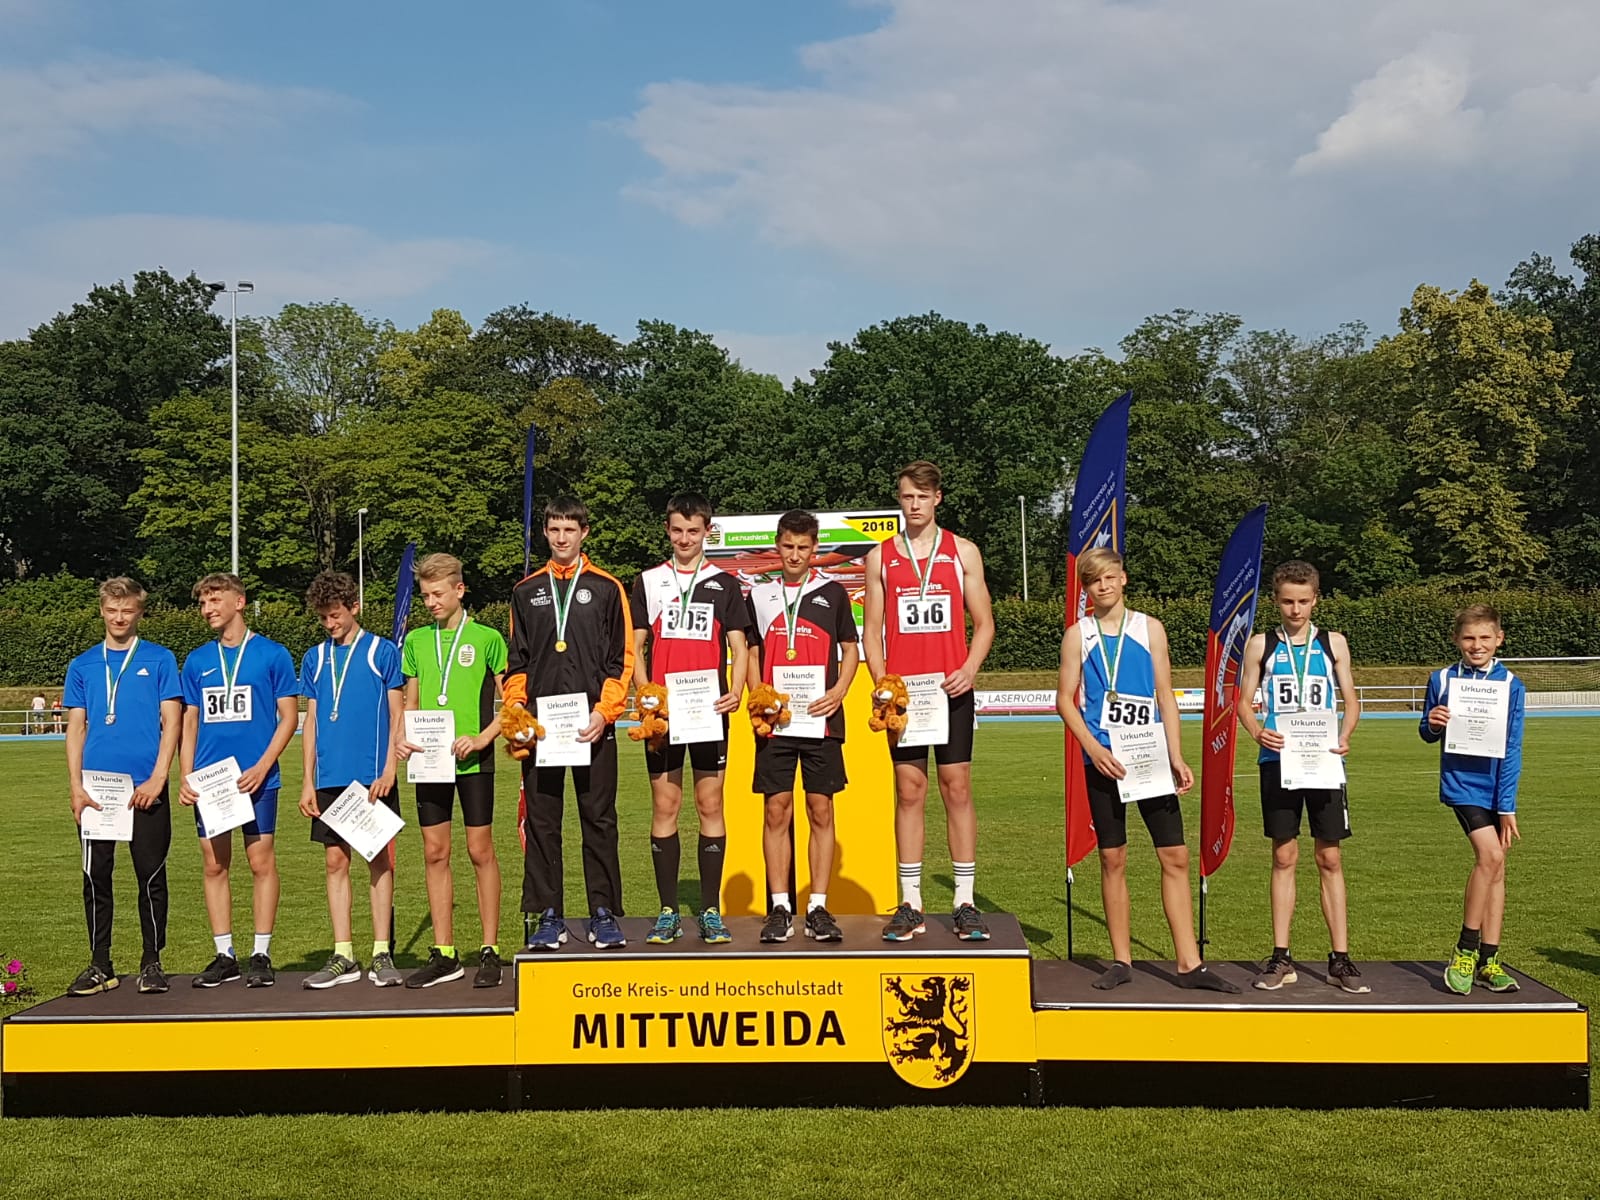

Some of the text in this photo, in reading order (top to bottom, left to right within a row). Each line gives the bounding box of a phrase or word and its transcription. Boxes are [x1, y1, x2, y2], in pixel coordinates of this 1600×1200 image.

[862, 521, 894, 532] 2018
[906, 603, 944, 625] 316
[676, 676, 708, 685] Urkunde
[1280, 683, 1322, 705] 58
[1461, 685, 1498, 694] Urkunde
[988, 693, 1051, 703] LASERVORM
[547, 700, 578, 709] Urkunde
[1108, 701, 1150, 726] 539
[1290, 719, 1326, 727] Urkunde
[1120, 731, 1154, 741] Urkunde
[92, 775, 123, 783] Urkunde
[197, 767, 229, 782] Urkunde
[330, 792, 356, 817] Urkunde
[572, 980, 844, 998] Große Kreis- und Hochschulstadt
[572, 1010, 846, 1049] MITTWEIDA
